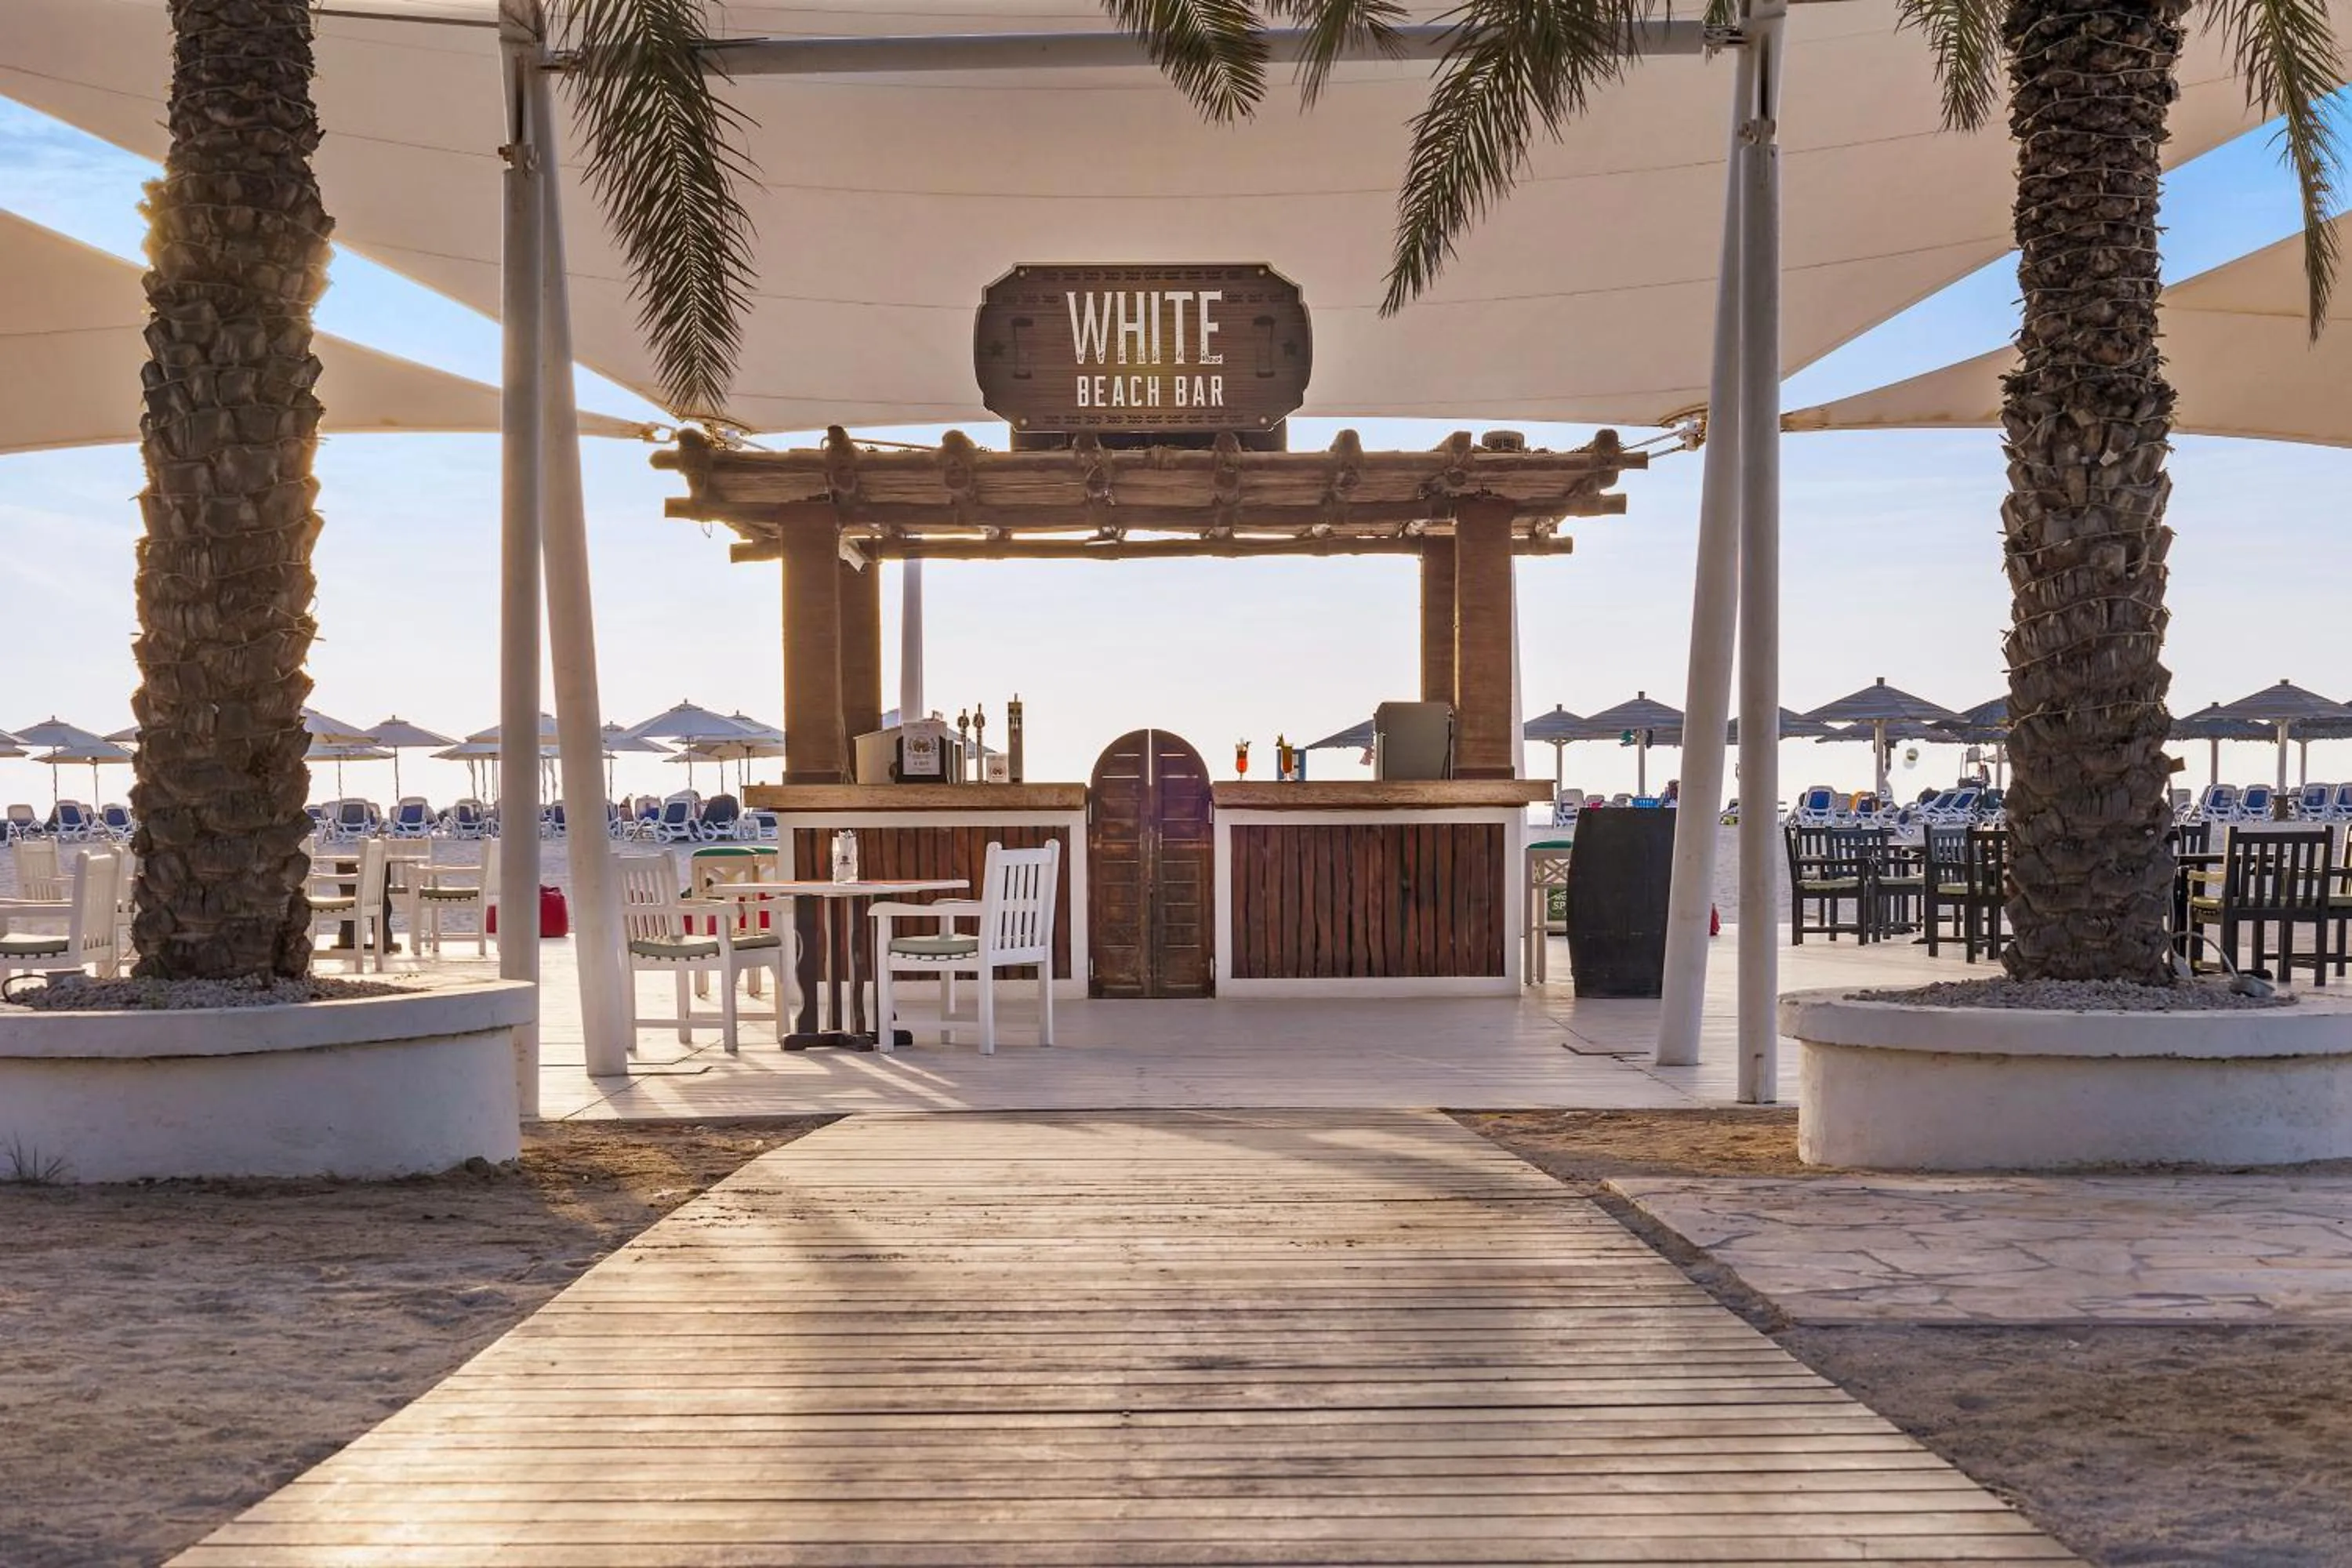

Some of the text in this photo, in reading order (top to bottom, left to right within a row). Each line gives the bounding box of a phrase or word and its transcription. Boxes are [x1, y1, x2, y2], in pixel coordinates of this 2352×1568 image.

[1066, 291, 1223, 365] WHITE
[1077, 376, 1224, 407] BEACH BAR
